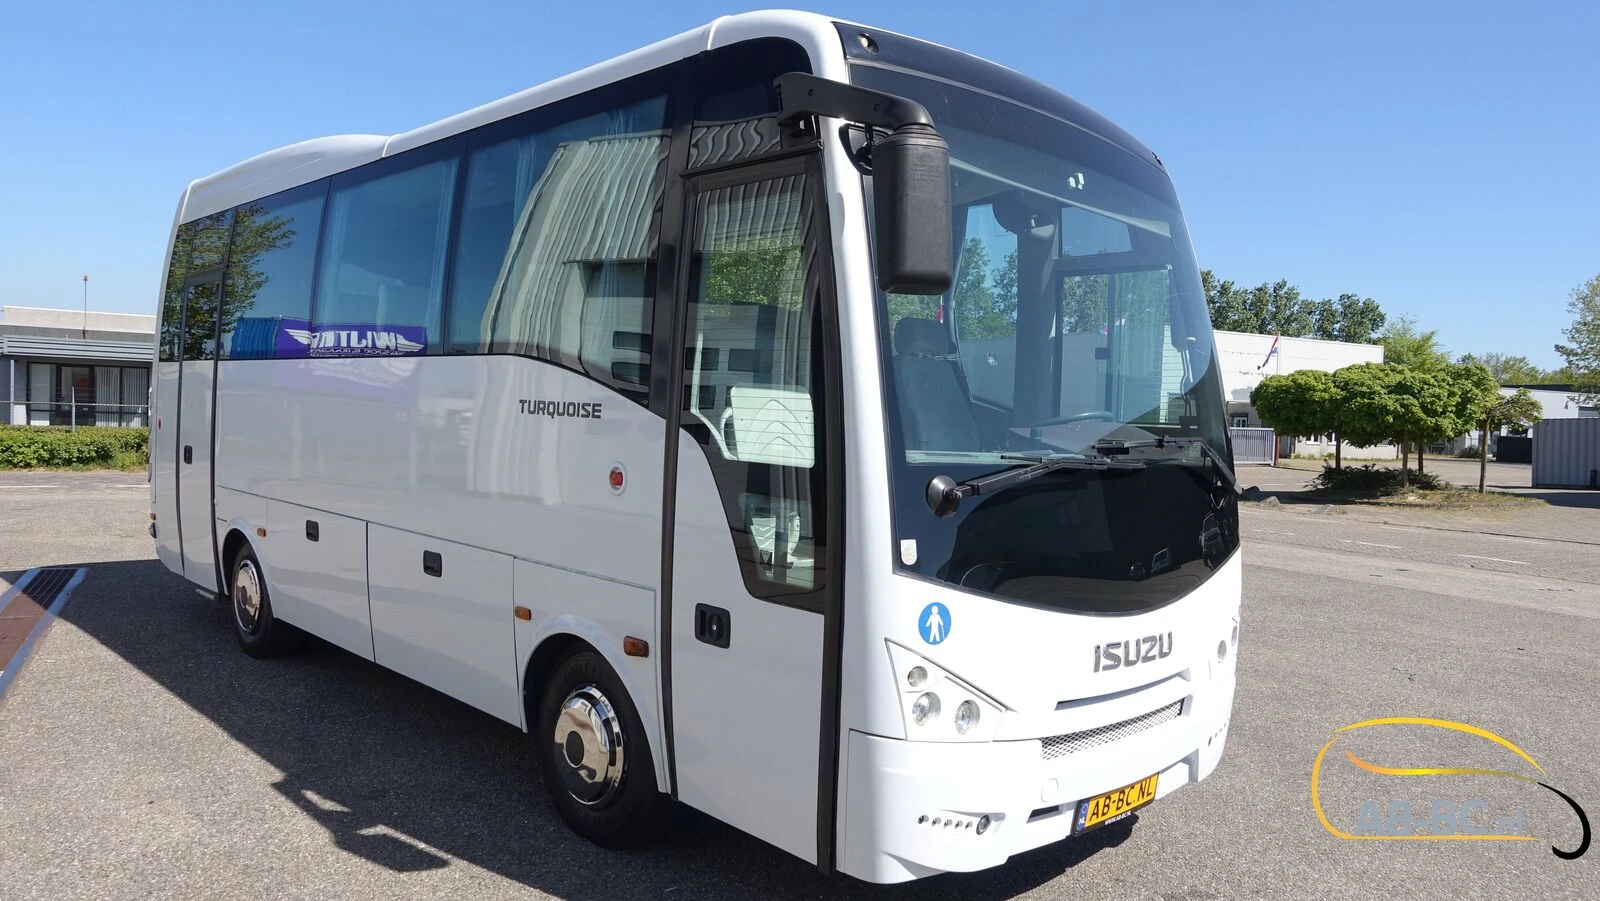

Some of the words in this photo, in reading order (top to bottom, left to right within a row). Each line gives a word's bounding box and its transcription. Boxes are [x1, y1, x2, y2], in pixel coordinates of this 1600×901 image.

[519, 399, 602, 419] TURQUOISE
[1093, 631, 1173, 673] ISUZU
[1089, 777, 1152, 821] AB-BC.NL
[1078, 817, 1086, 825] NL
